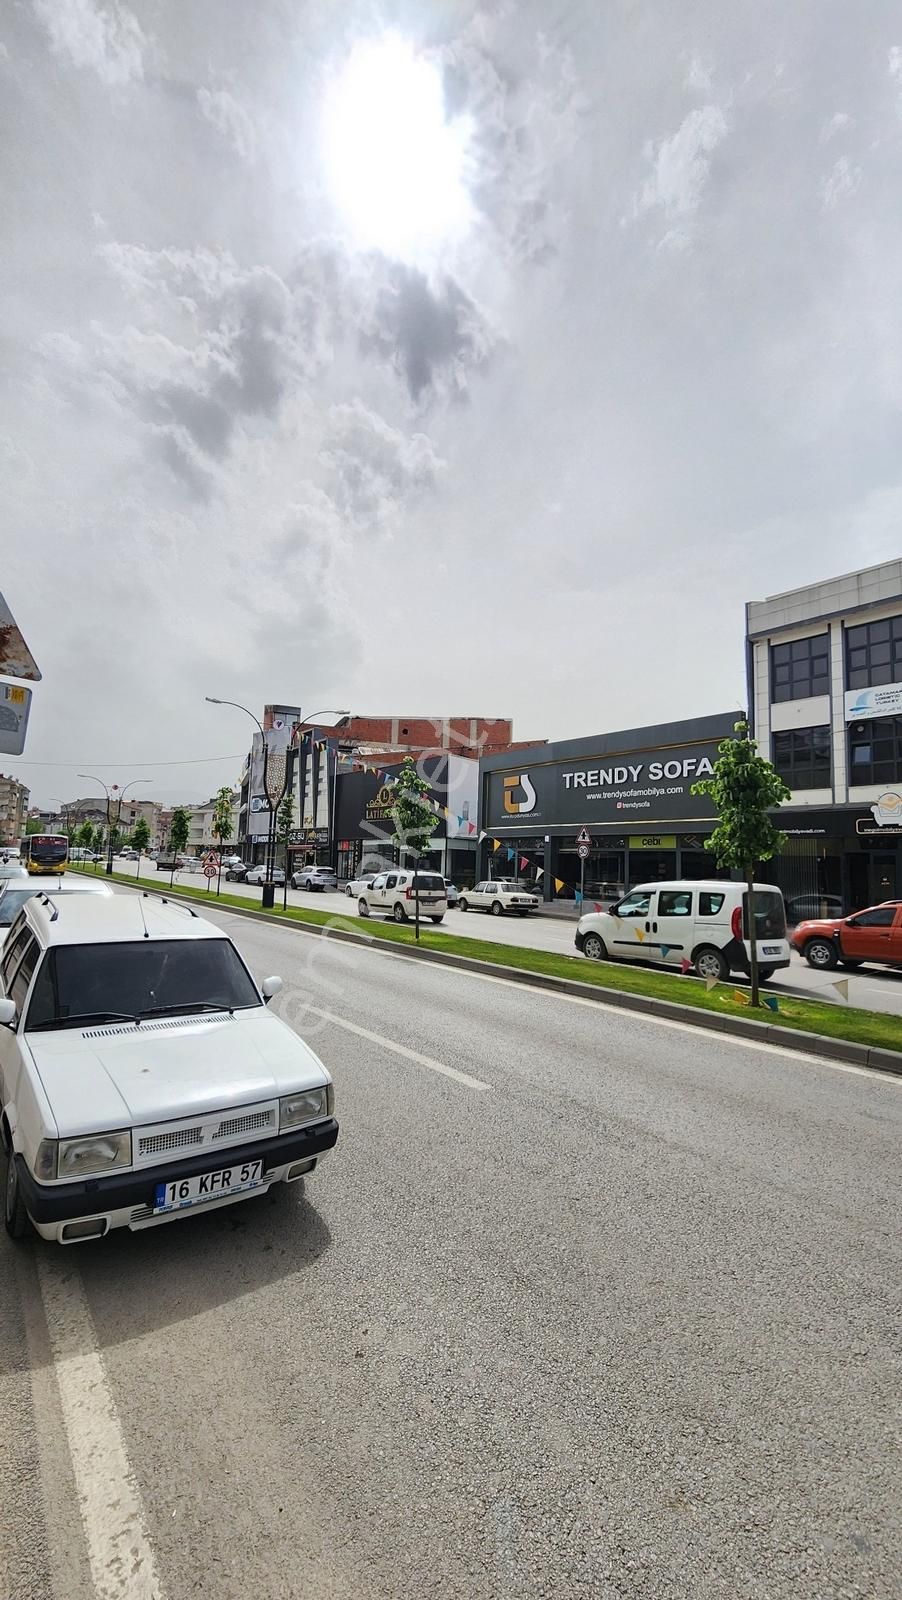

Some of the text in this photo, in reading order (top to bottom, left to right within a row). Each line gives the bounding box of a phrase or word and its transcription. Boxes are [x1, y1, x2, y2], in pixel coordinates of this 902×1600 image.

[563, 757, 714, 788] TRENDY SOFA
[586, 786, 684, 801] www.trendysofamobilya.com
[622, 801, 651, 810] trendysofa
[206, 868, 215, 876] 30
[169, 1180, 190, 1202] 16
[199, 1170, 232, 1194] KFR
[240, 1161, 261, 1183] 57
